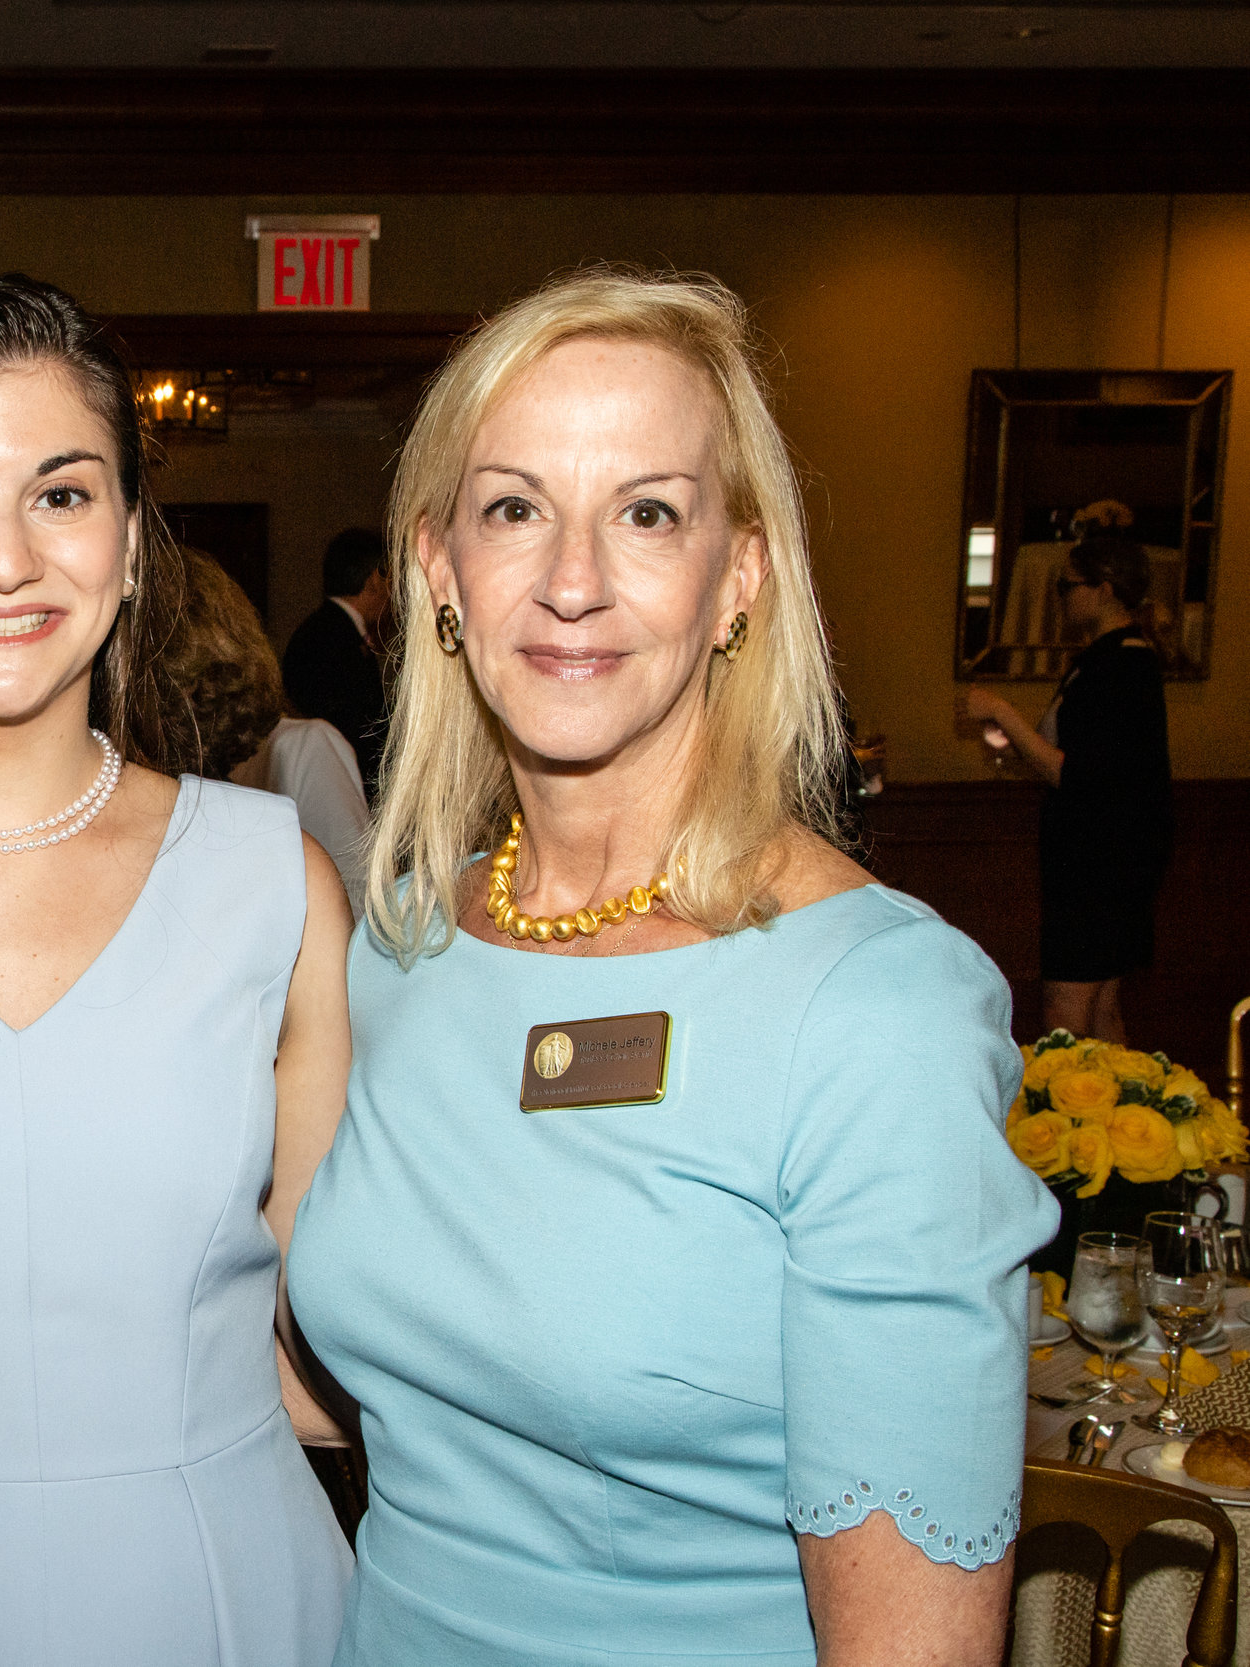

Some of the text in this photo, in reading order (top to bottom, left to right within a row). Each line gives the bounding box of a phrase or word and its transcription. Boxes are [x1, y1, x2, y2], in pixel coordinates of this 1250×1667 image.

[274, 238, 360, 306] EXIT
[578, 1036, 656, 1053] Michele Jeffery
